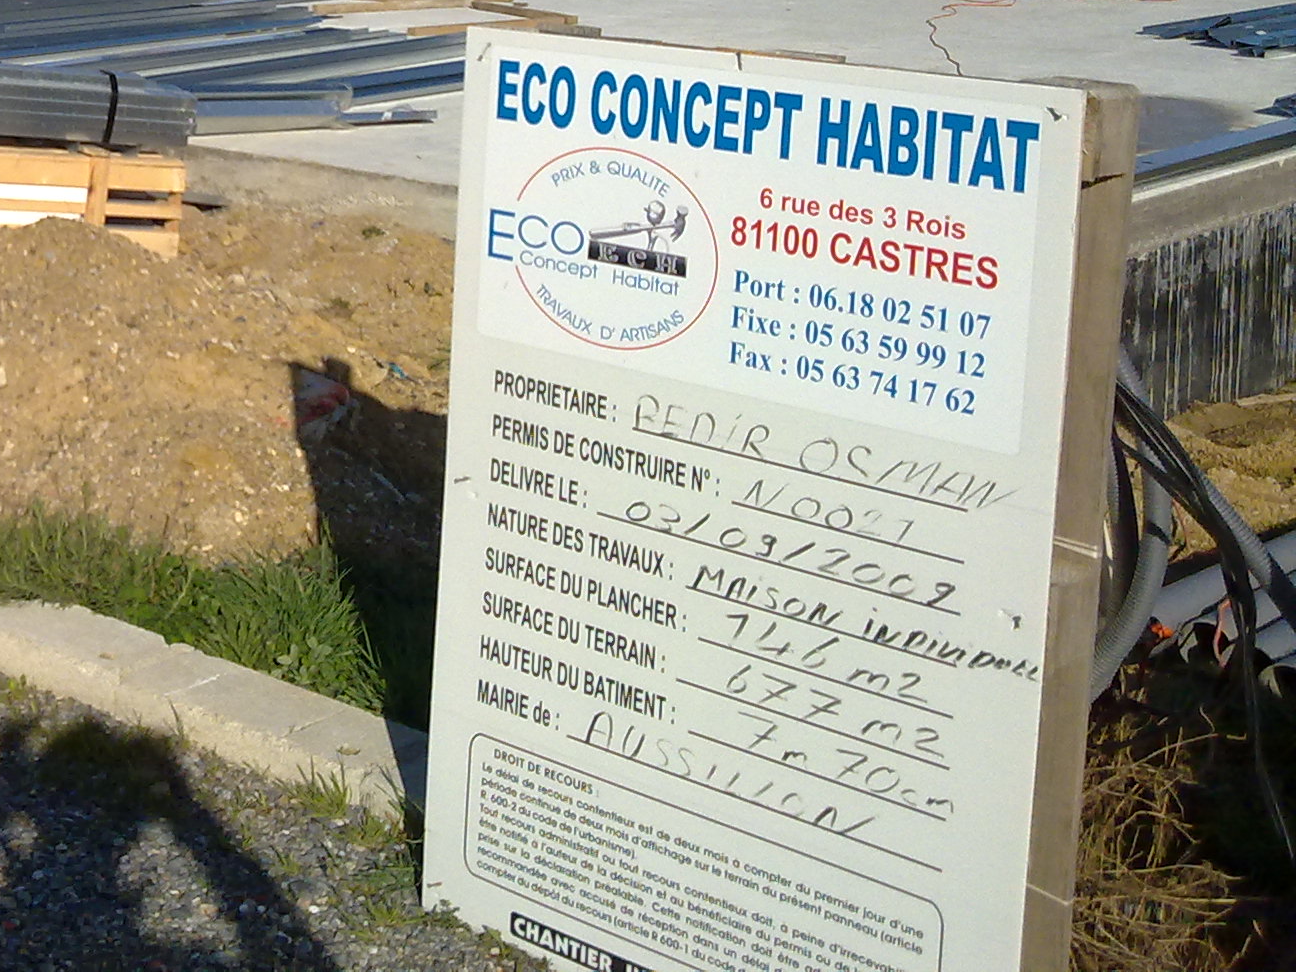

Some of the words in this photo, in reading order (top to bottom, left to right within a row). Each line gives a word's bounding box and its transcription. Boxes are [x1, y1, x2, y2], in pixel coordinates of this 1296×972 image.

[495, 57, 578, 131] ECO
[588, 68, 803, 162] CONCEPT
[815, 96, 1041, 196] HABITAT
[552, 162, 585, 187] PRIX
[590, 161, 600, 174] &
[607, 161, 670, 197] QUALITE
[488, 208, 584, 261] ECO
[758, 186, 774, 210] 6
[780, 194, 820, 218] rue
[828, 196, 875, 226] des
[881, 205, 898, 230] 3
[905, 208, 967, 241] Rois
[520, 250, 597, 279] Concept
[612, 270, 679, 296] Habitat
[729, 214, 819, 260] 81100
[828, 230, 1000, 291] CASTRES
[537, 284, 592, 334] TRAVAUX
[620, 310, 684, 342] ARTISANS
[807, 282, 875, 320] 06.18
[881, 295, 912, 327] 02
[919, 302, 950, 333] 51
[957, 309, 992, 341] 07
[803, 318, 834, 349] 05
[840, 325, 870, 356] 63
[876, 333, 908, 364] 59
[914, 340, 947, 372] 99
[956, 348, 987, 380] 12
[794, 354, 825, 384] 05
[830, 361, 861, 392] 63
[867, 369, 899, 400] 74
[907, 377, 938, 409] 17
[943, 384, 977, 417] 62
[489, 457, 555, 499] DELIVRE
[491, 413, 550, 452] PERMIS
[553, 428, 575, 459] DE
[578, 436, 687, 488] CONSTRUIRE
[487, 501, 548, 543] NATURE
[552, 520, 584, 554] DES
[484, 545, 556, 592] SURFACE
[559, 569, 582, 600] DU
[481, 589, 554, 636] SURFACE
[557, 614, 580, 645] DU
[479, 633, 553, 682] HAUTEUR
[556, 660, 580, 692] DU
[476, 677, 530, 720] MAIRIE
[728, 663, 842, 723] 677
[493, 747, 525, 770] DROIT
[527, 759, 540, 775] DE
[481, 761, 492, 774] Le
[521, 776, 534, 790] de
[576, 799, 635, 829] contentieux
[813, 889, 859, 914] premier
[683, 885, 747, 918] contentieux
[823, 909, 877, 937] panneau
[512, 913, 613, 972] CHANTIER
[685, 916, 746, 948] notification
